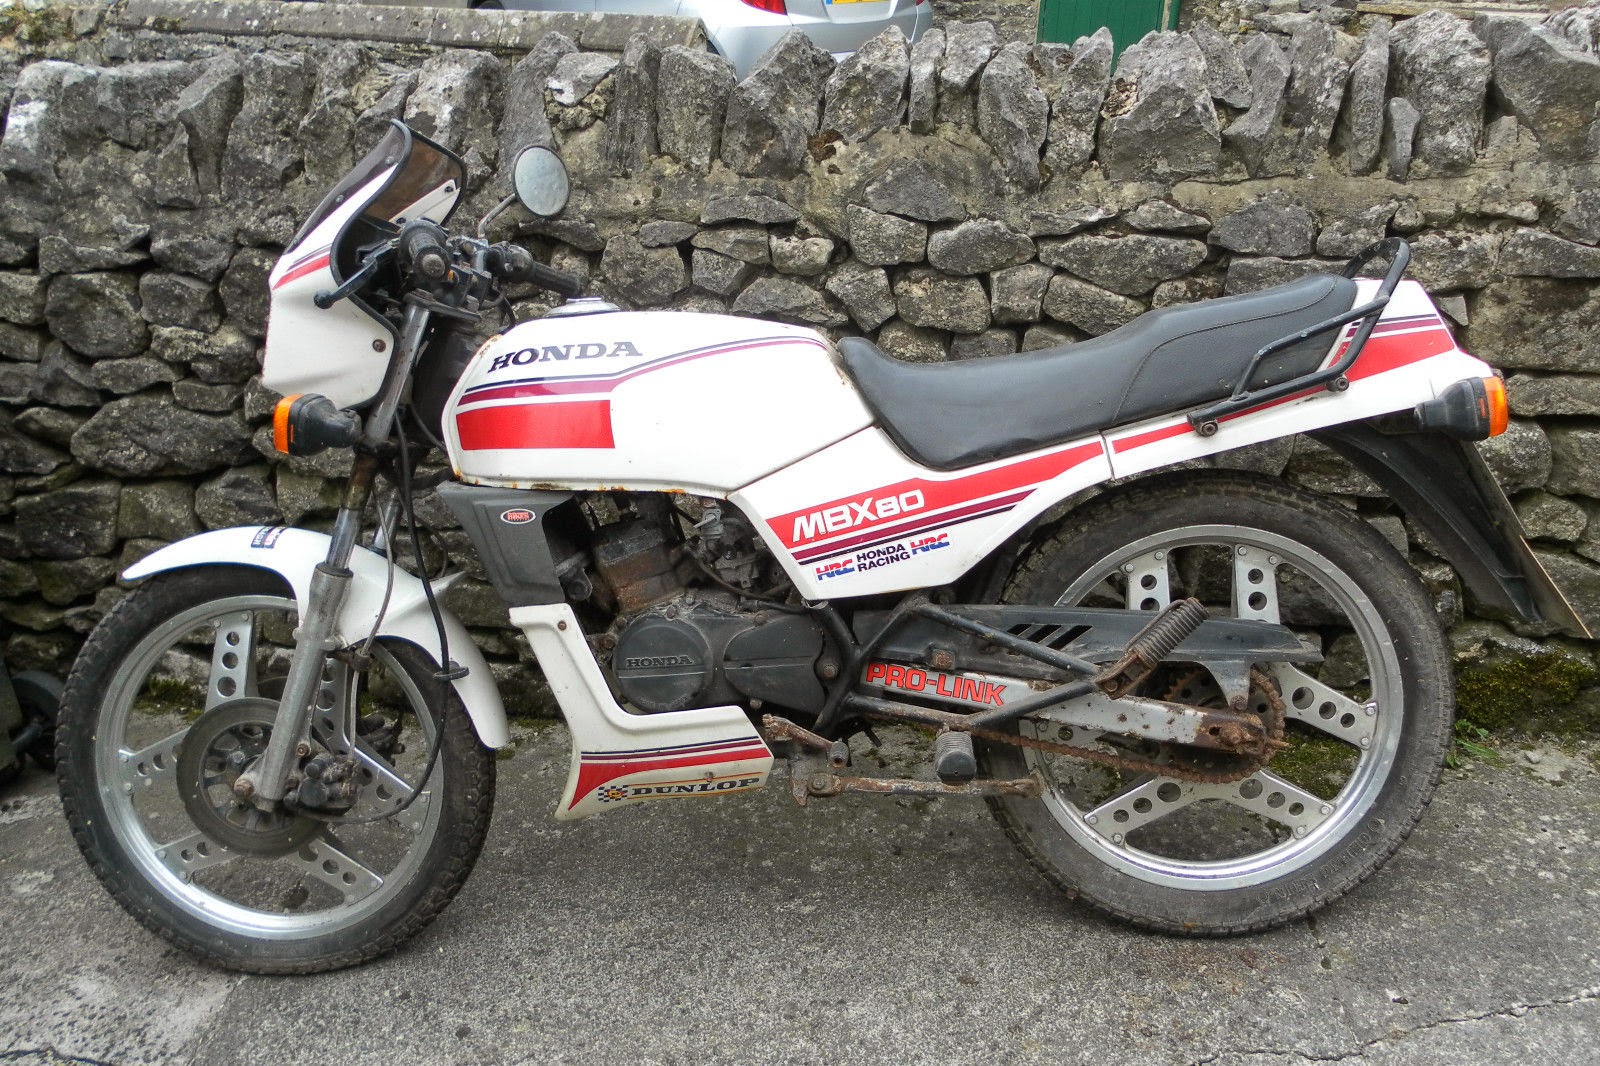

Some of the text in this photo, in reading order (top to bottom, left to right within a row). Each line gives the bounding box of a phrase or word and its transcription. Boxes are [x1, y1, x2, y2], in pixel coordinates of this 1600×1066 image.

[487, 341, 643, 373] HONDA
[792, 489, 925, 543] MBX80
[856, 543, 906, 563] HONDA
[909, 532, 950, 555] HRC
[816, 558, 856, 581] HRC
[857, 551, 911, 572] RACING
[625, 654, 696, 669] HONDA
[866, 662, 1007, 706] PRO-LINK
[631, 777, 760, 796] DUNLOP
